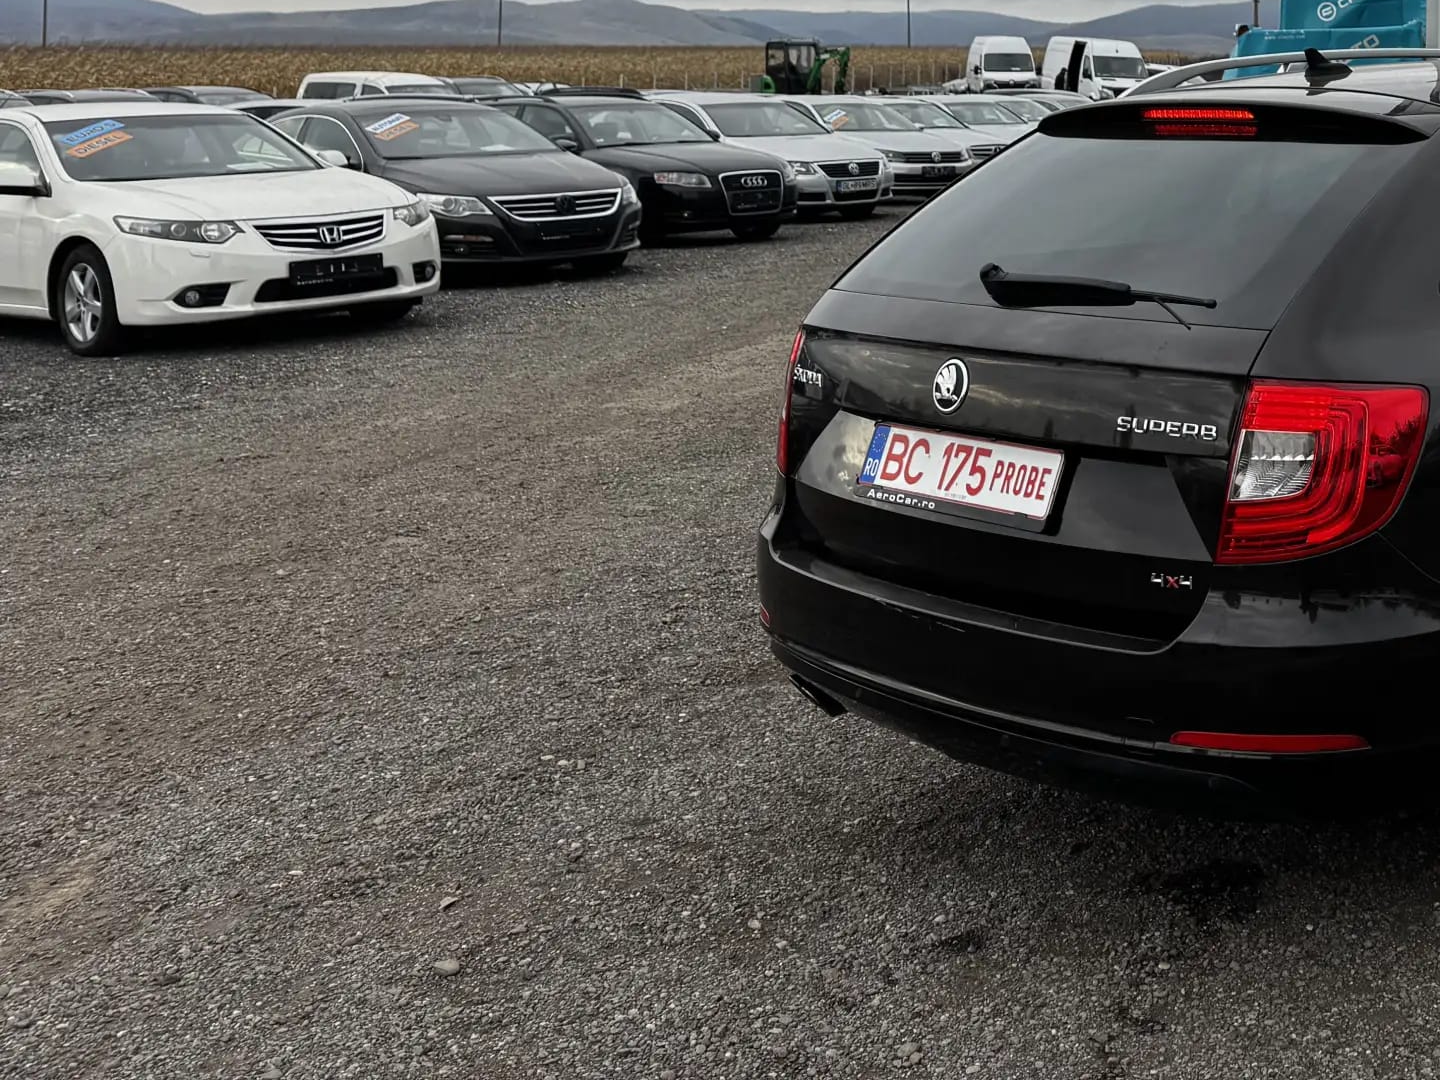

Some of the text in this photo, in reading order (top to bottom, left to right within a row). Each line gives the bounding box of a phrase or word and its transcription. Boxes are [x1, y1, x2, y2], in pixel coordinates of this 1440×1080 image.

[1116, 416, 1217, 440] SUPERB
[863, 457, 880, 477] RO
[880, 433, 1052, 501] BC 175 PROBE
[867, 488, 936, 510] AeroCar.ro
